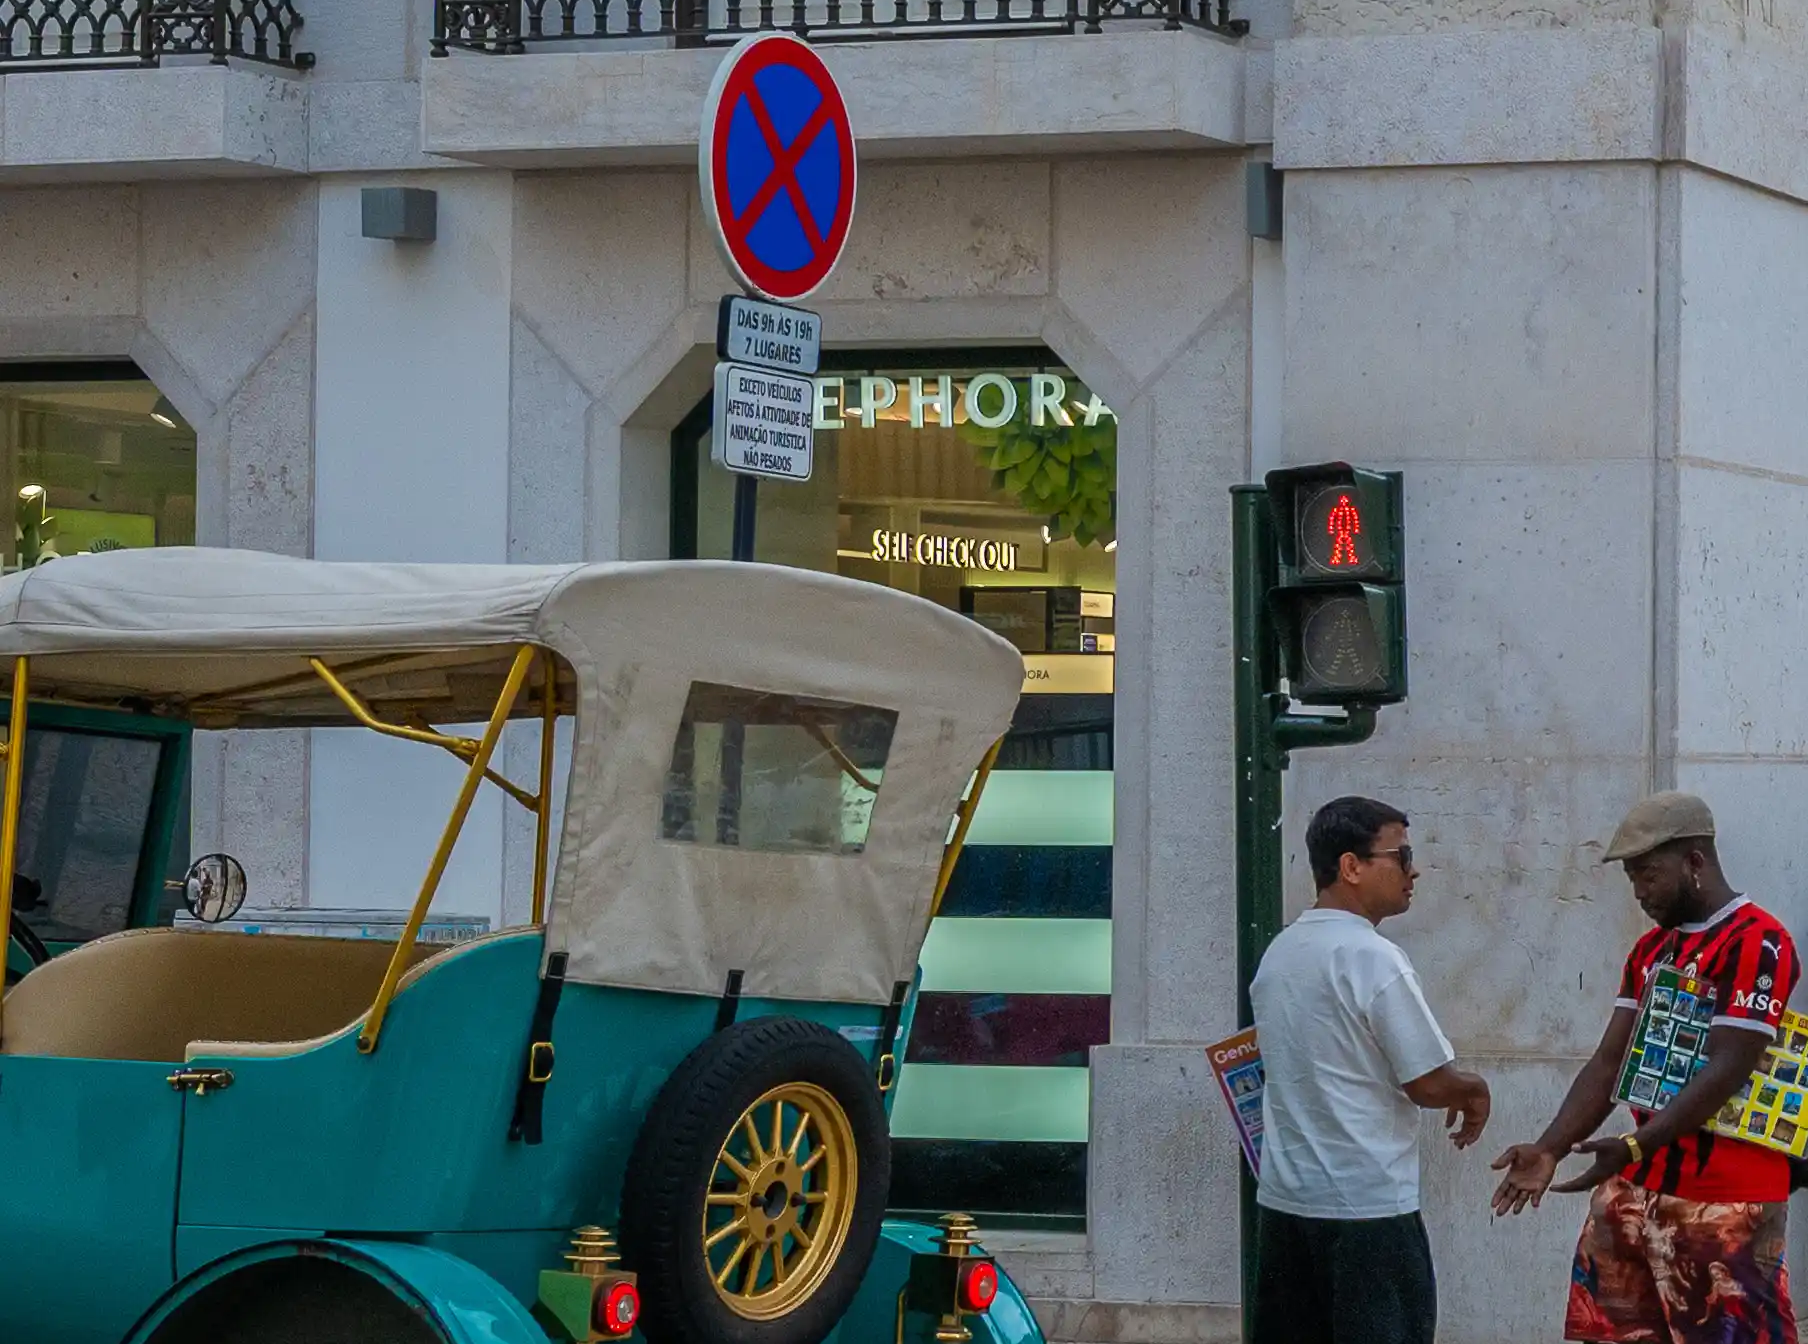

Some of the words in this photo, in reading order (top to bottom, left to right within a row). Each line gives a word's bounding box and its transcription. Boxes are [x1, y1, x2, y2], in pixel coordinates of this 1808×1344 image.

[737, 308, 758, 331] DAS
[761, 313, 775, 332] 9h
[776, 312, 791, 337] ÀS
[794, 319, 813, 341] 19h
[745, 337, 752, 354] 7
[754, 341, 802, 365] LUGARES
[739, 377, 766, 397] EXCETO
[812, 373, 1118, 429] EPHORA
[727, 399, 754, 419] AFETOS
[761, 404, 800, 427] ATIVIDADE
[801, 412, 812, 429] DE
[760, 452, 792, 472] PESADOS
[915, 532, 977, 570] CHECK
[978, 538, 1019, 572] OUT
[1733, 989, 1782, 1017] MSC
[1214, 1042, 1258, 1064] Genu
